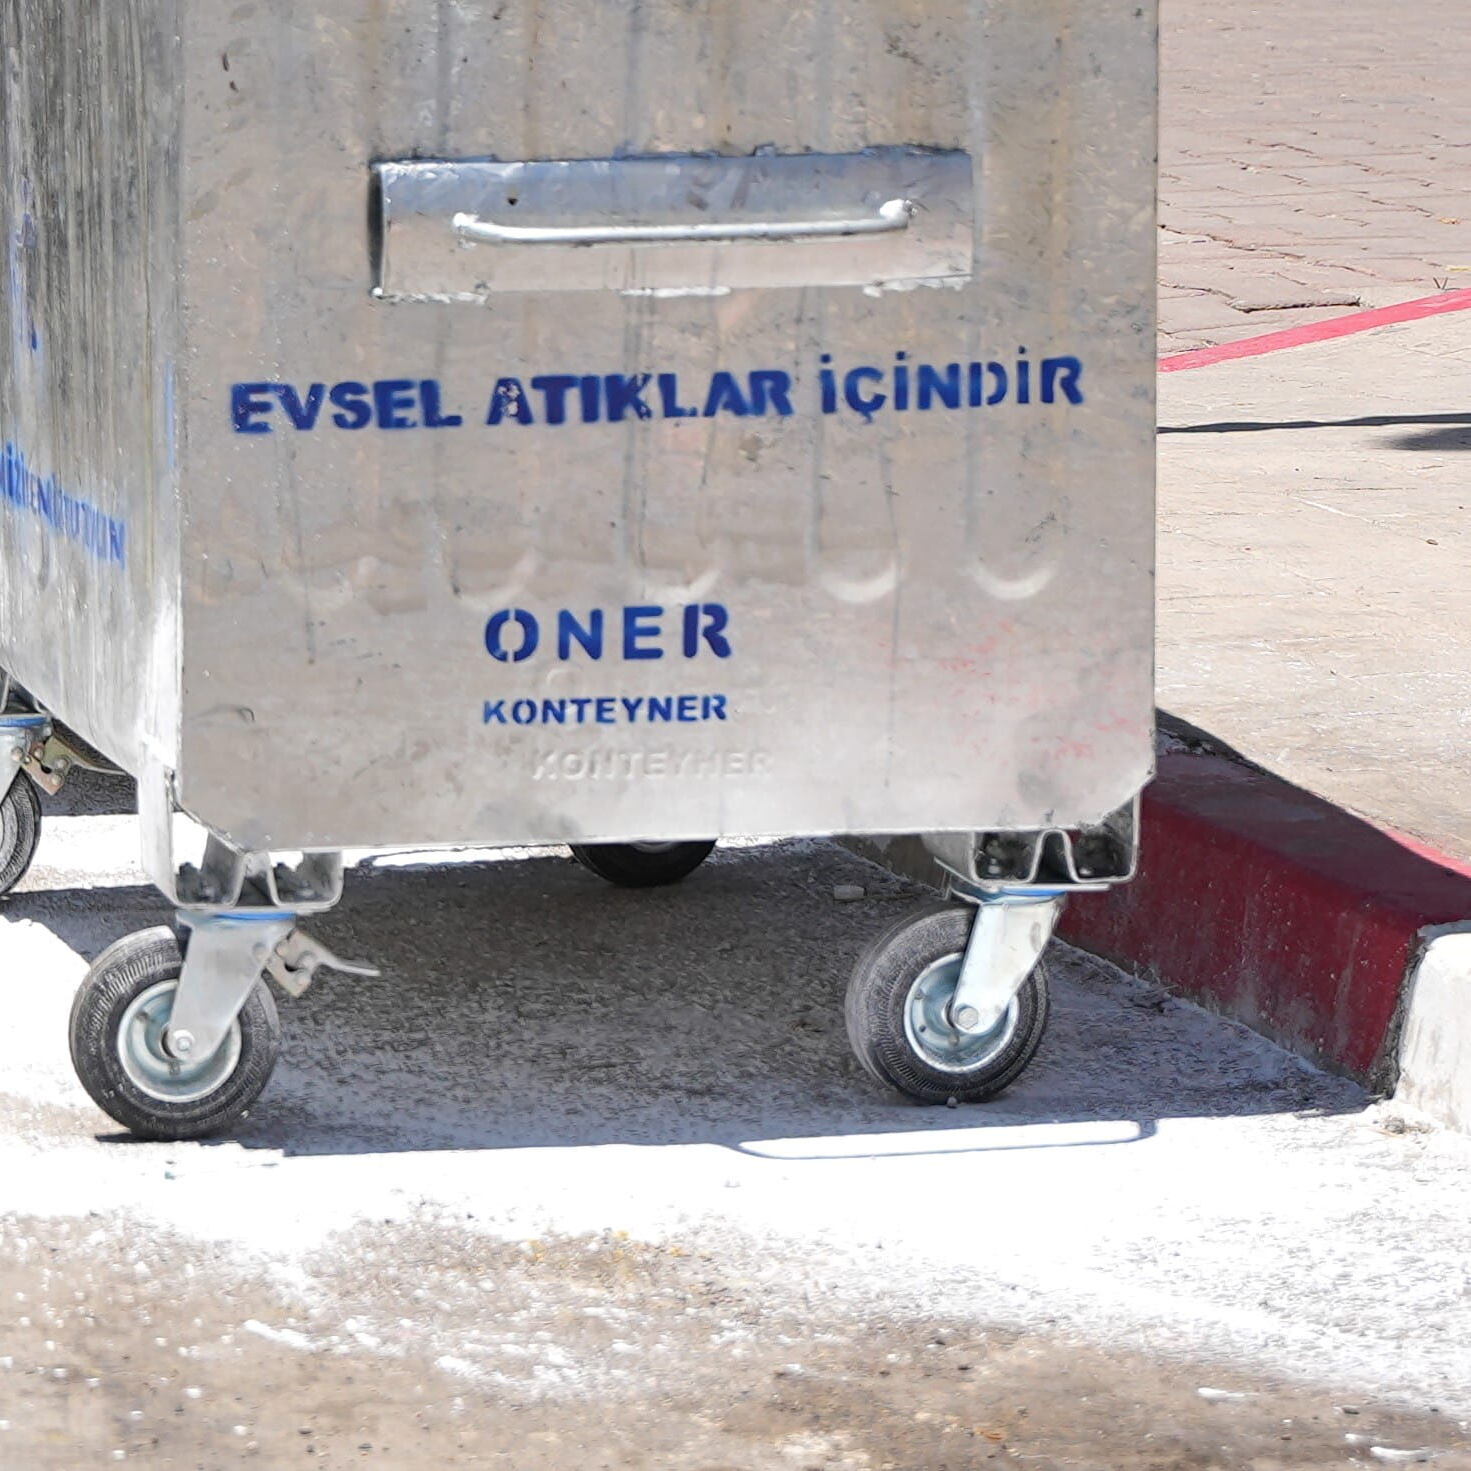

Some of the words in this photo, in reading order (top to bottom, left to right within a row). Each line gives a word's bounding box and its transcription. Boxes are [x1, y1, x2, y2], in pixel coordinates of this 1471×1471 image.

[230, 379, 463, 434] EVSEL
[486, 370, 795, 426] ATIKLAR
[818, 344, 1085, 425] İÇİNDİR
[484, 603, 732, 663] ONER
[483, 693, 729, 725] KONTEYNER
